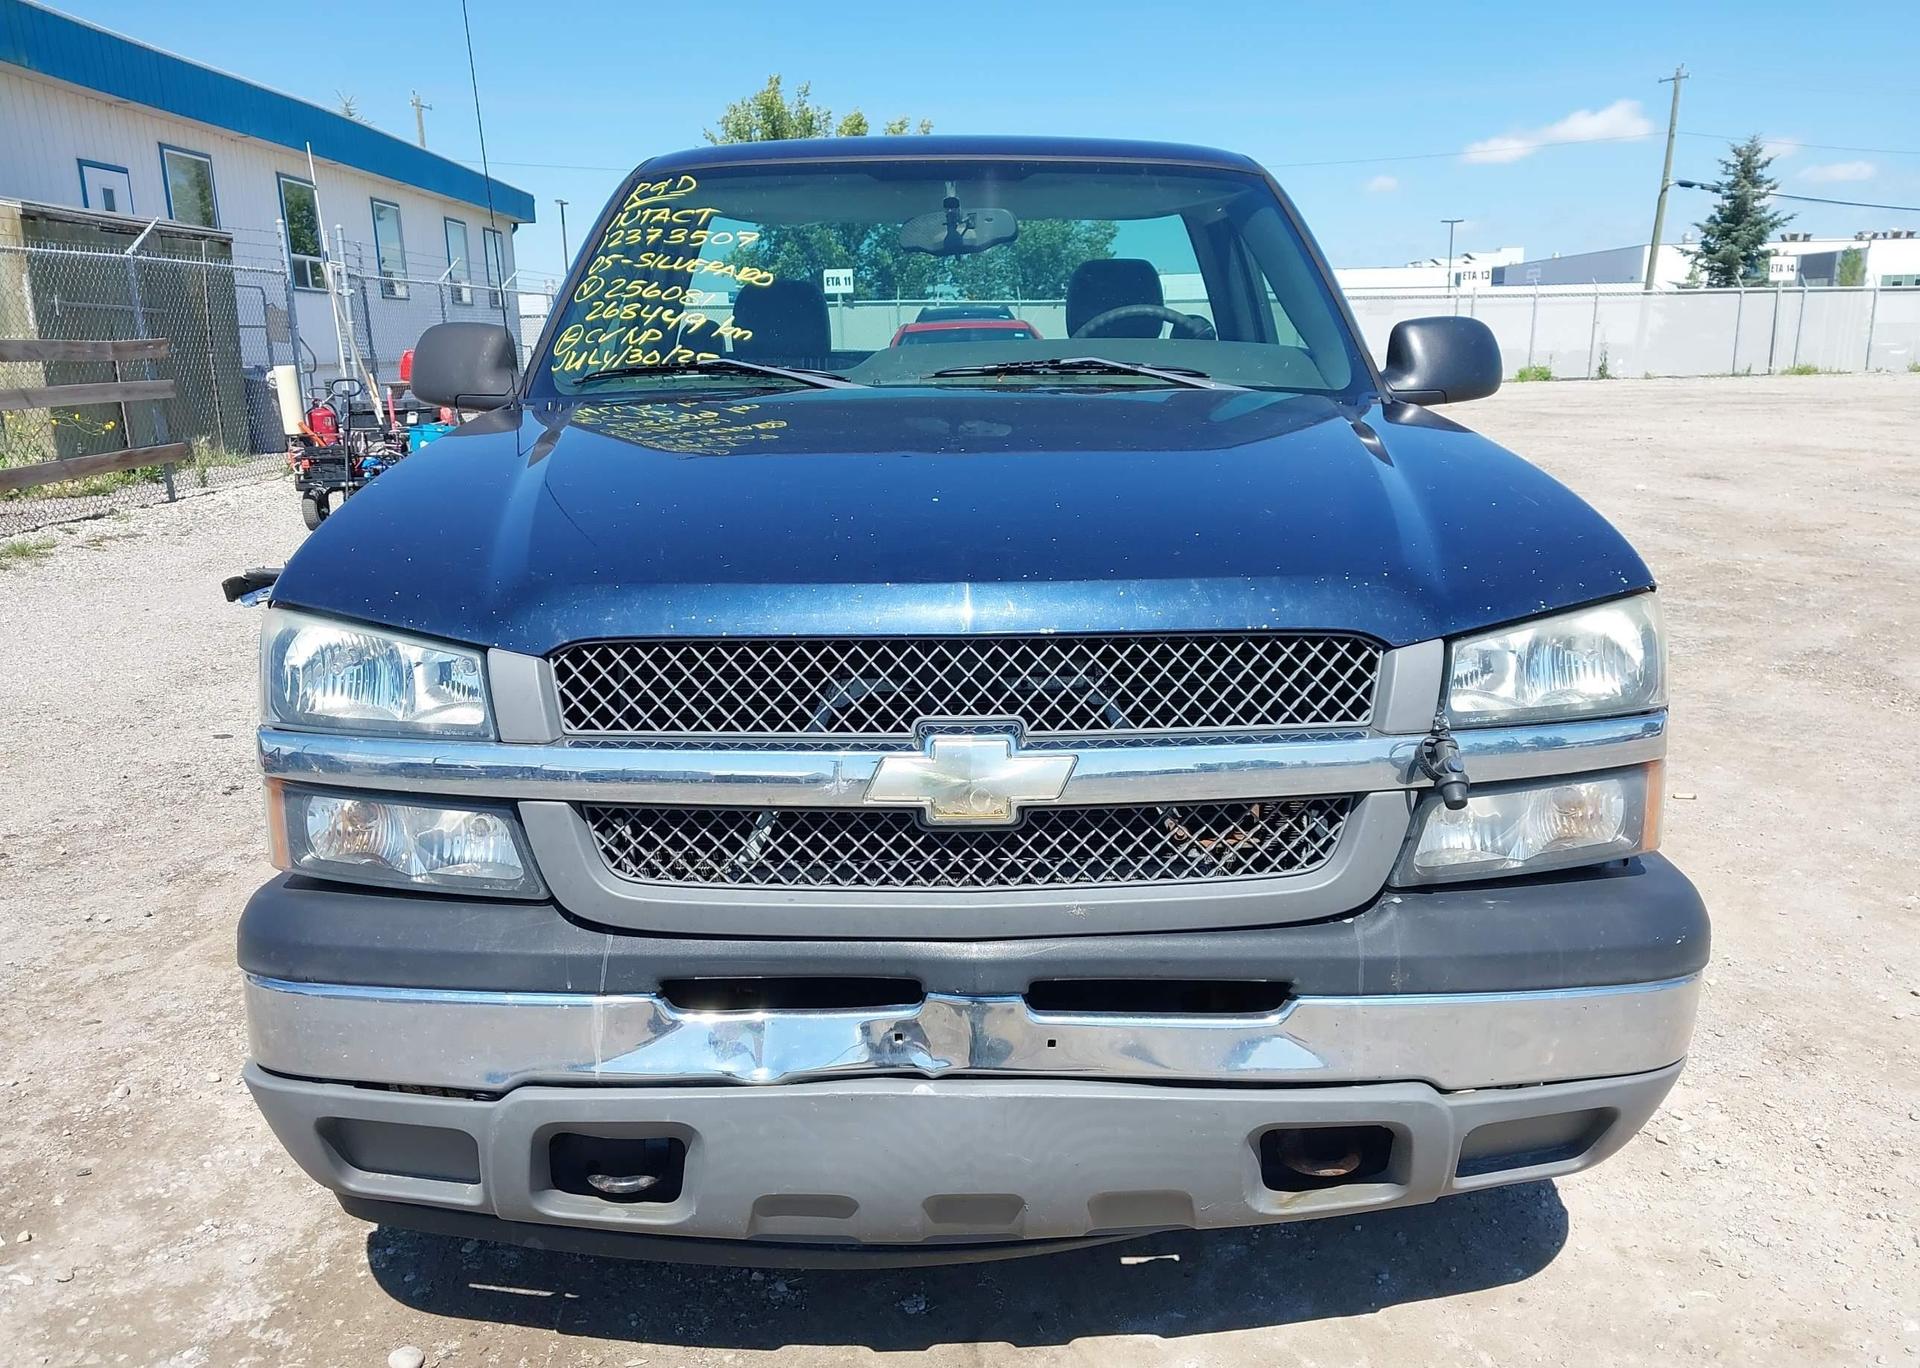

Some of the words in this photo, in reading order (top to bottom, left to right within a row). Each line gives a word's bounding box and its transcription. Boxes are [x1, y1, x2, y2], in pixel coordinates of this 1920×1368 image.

[597, 226, 760, 254] 12373507
[1771, 264, 1783, 273] ETA
[1787, 264, 1795, 272] 14
[1463, 271, 1477, 280] ETA
[1481, 271, 1490, 280] 13
[826, 276, 841, 286] ETA
[844, 276, 851, 286] 11
[585, 300, 708, 335] 268449
